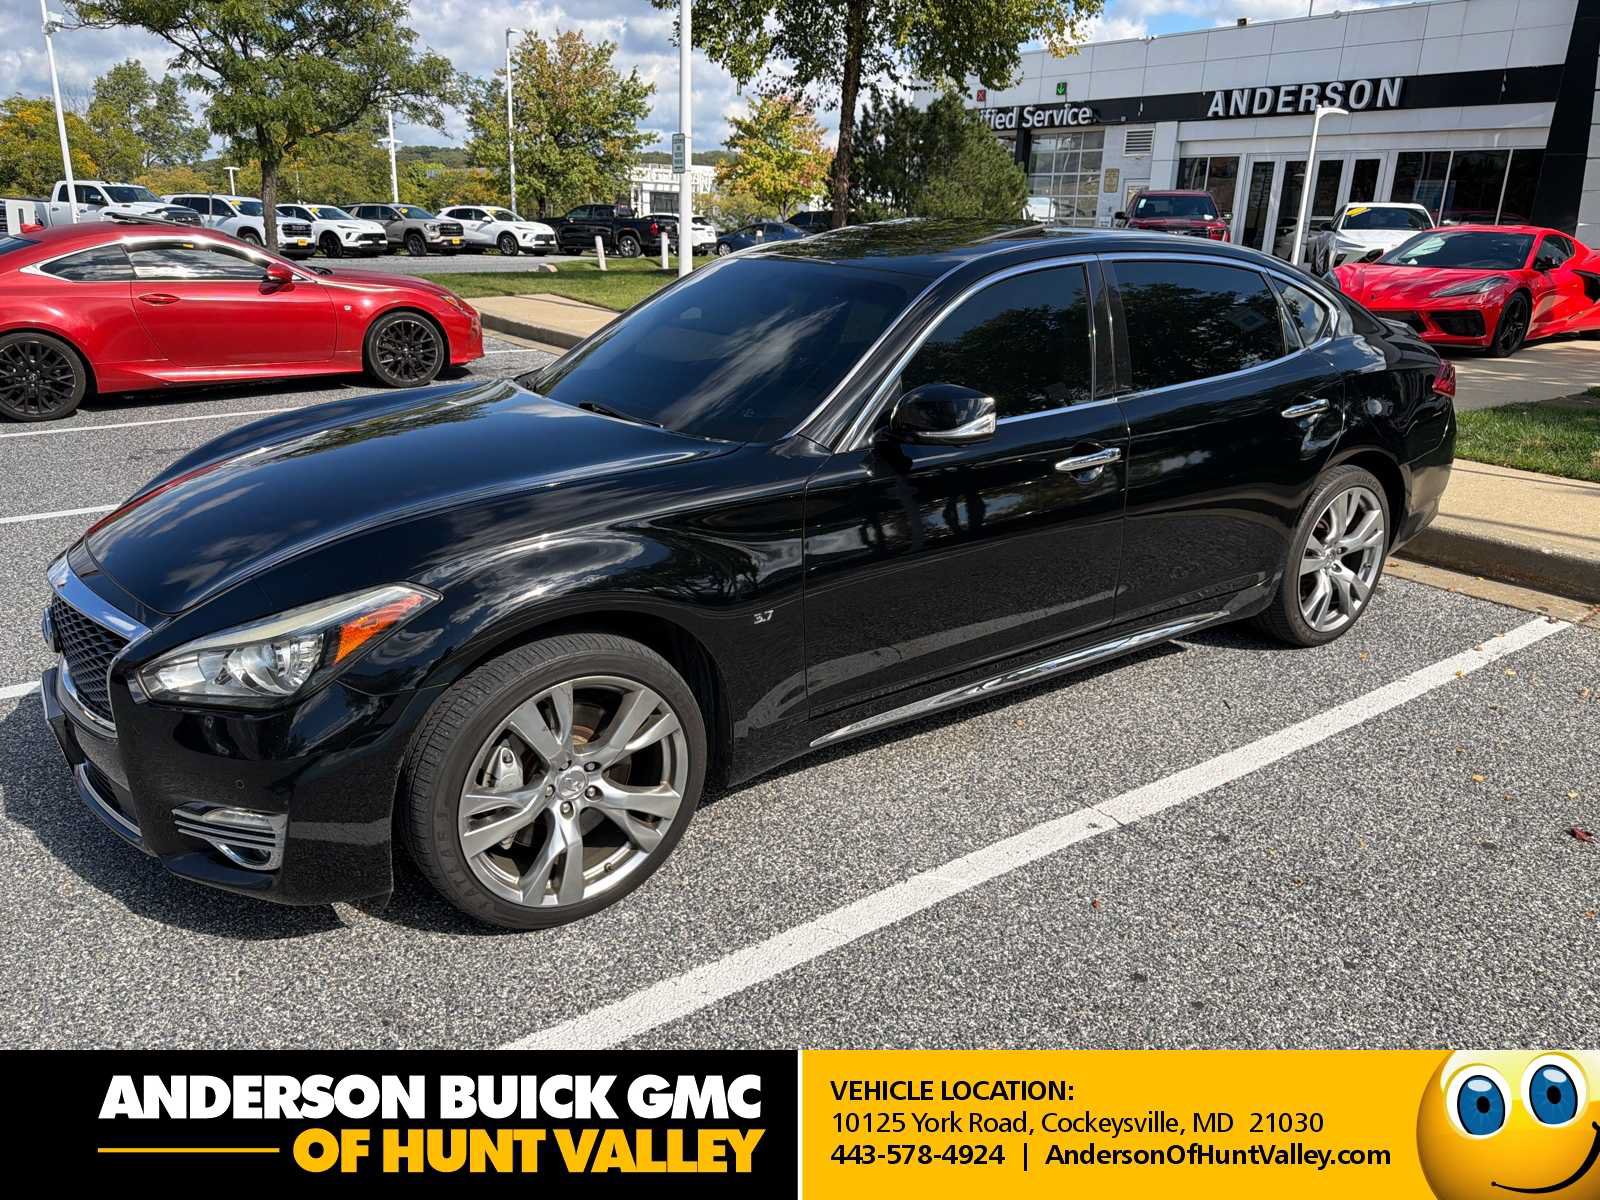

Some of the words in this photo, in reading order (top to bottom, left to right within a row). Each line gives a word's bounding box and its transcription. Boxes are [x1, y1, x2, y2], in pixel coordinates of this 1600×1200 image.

[1207, 77, 1403, 117] ANDERSON
[978, 106, 1020, 130] ified
[1022, 103, 1092, 128] Service
[753, 609, 775, 625] 3.7
